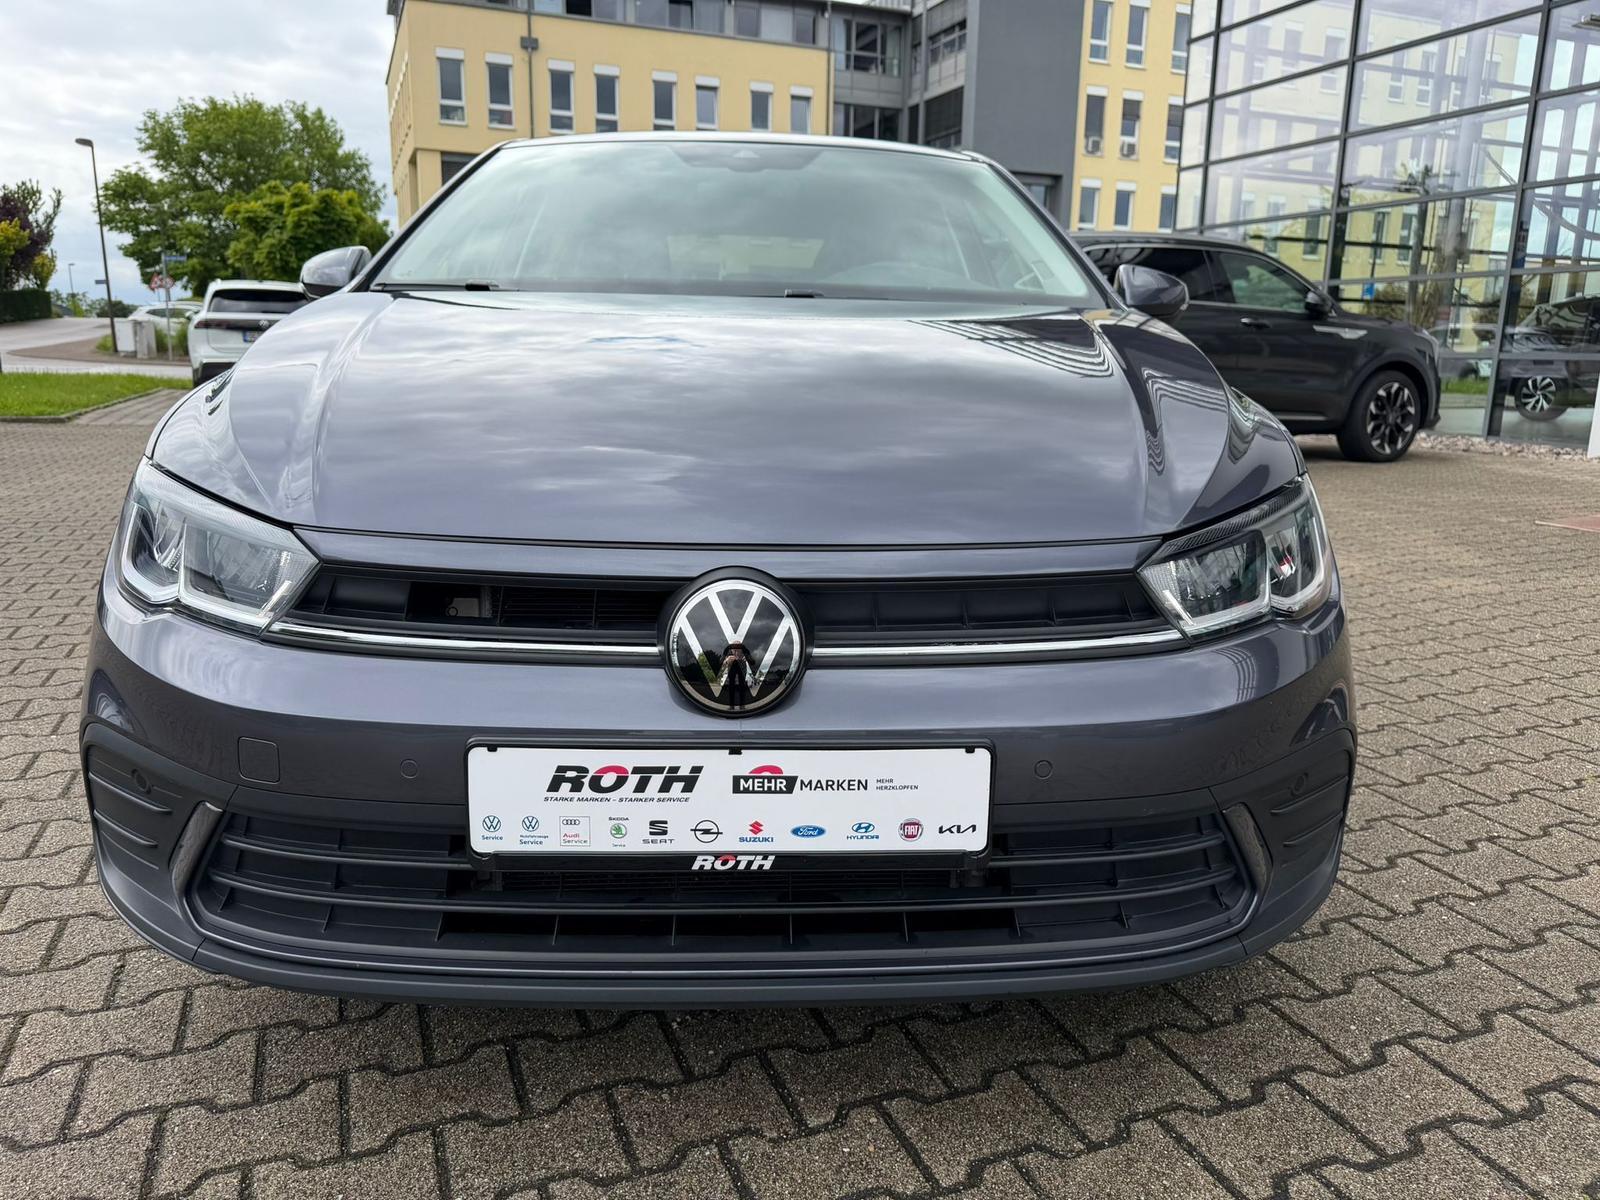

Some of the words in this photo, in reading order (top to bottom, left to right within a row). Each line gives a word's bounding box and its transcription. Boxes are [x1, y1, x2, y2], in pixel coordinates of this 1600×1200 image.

[546, 765, 704, 794] ROTH
[739, 778, 787, 791] MEHR
[800, 779, 868, 791] MARKEN
[797, 826, 819, 836] Ford
[904, 825, 919, 836] FIAT
[938, 824, 977, 834] KIA
[691, 854, 776, 871] ROTH
